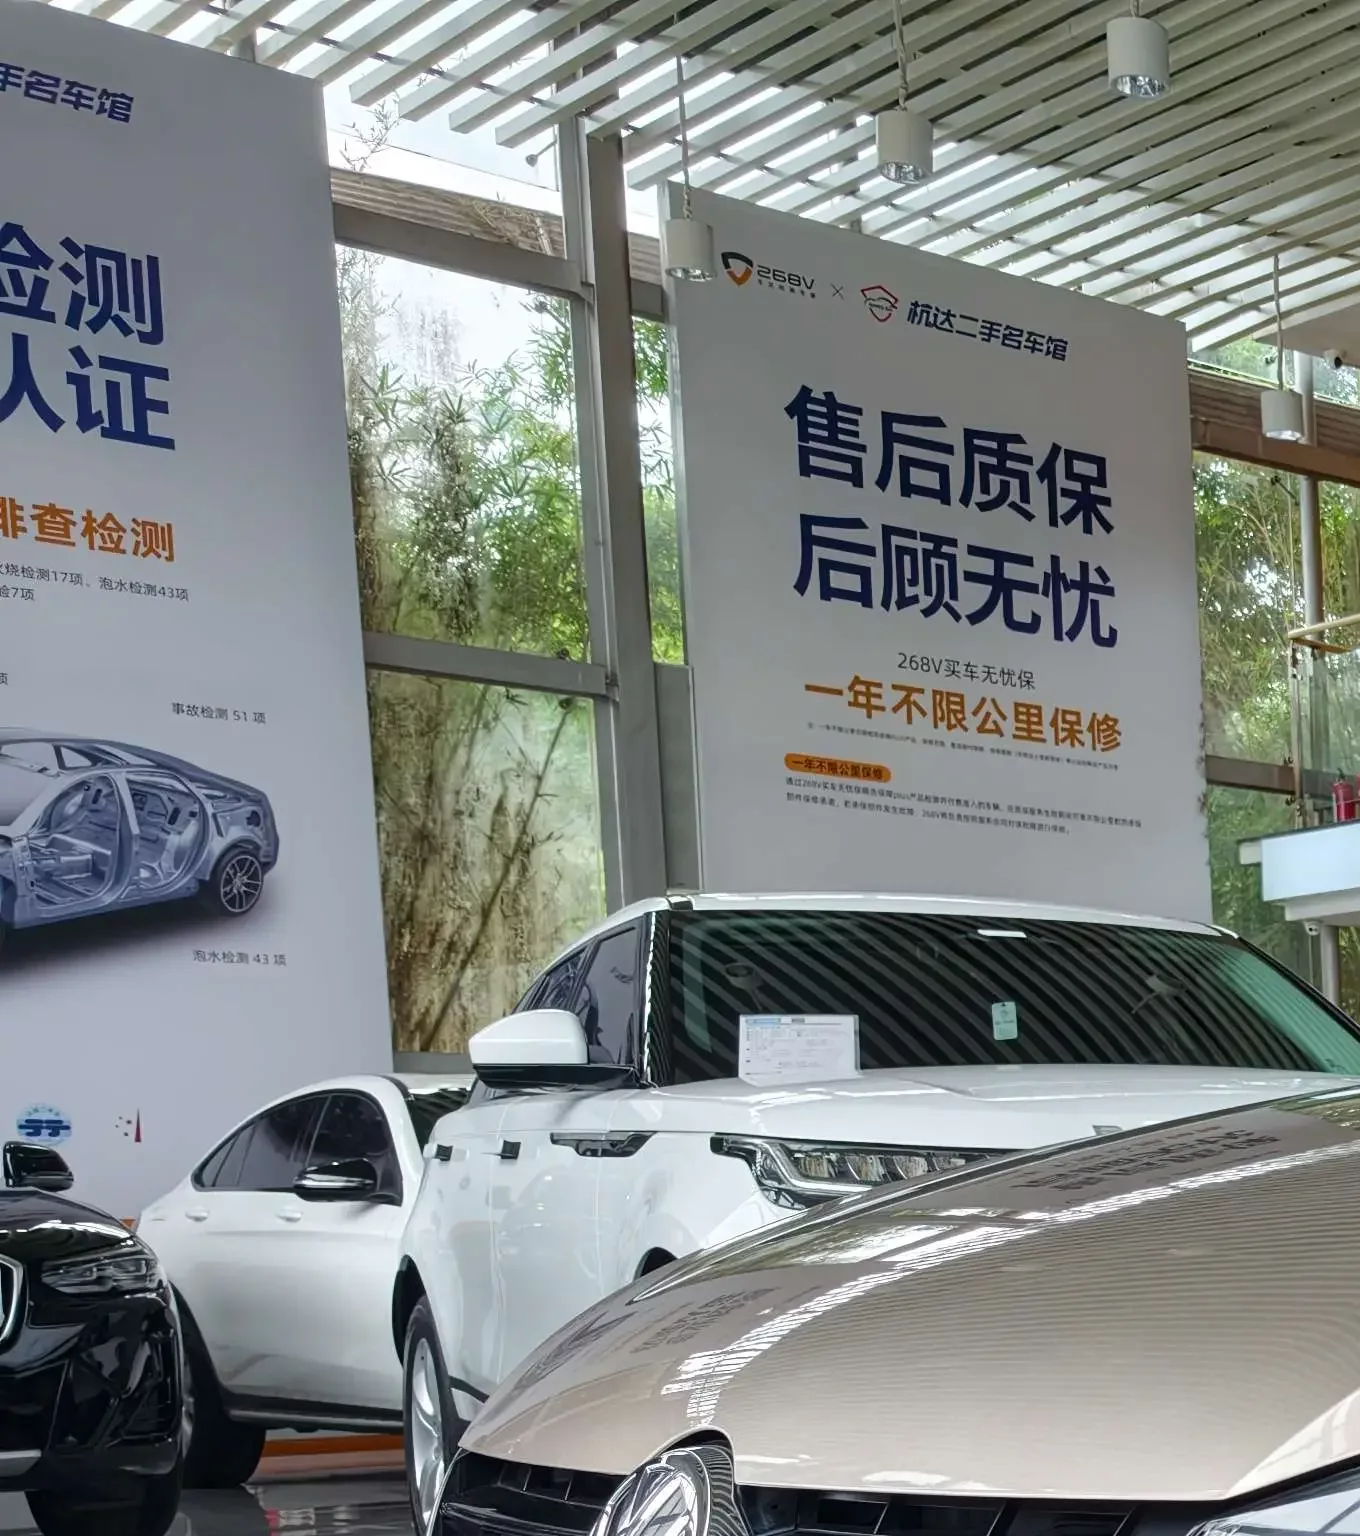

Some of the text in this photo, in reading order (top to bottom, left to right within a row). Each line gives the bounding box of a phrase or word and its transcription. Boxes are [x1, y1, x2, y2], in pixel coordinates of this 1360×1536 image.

[757, 264, 815, 290] 268V
[907, 300, 1068, 361] 杭达二手名车馆
[784, 384, 1115, 536] 售后质保
[0, 562, 190, 602] 烧检测17项、泡水检测43项
[793, 512, 1119, 649] 后顾无忧
[897, 652, 1036, 690] 268V买车无忧保
[233, 709, 248, 722] 51
[804, 674, 1122, 752] 一年不限公里保修
